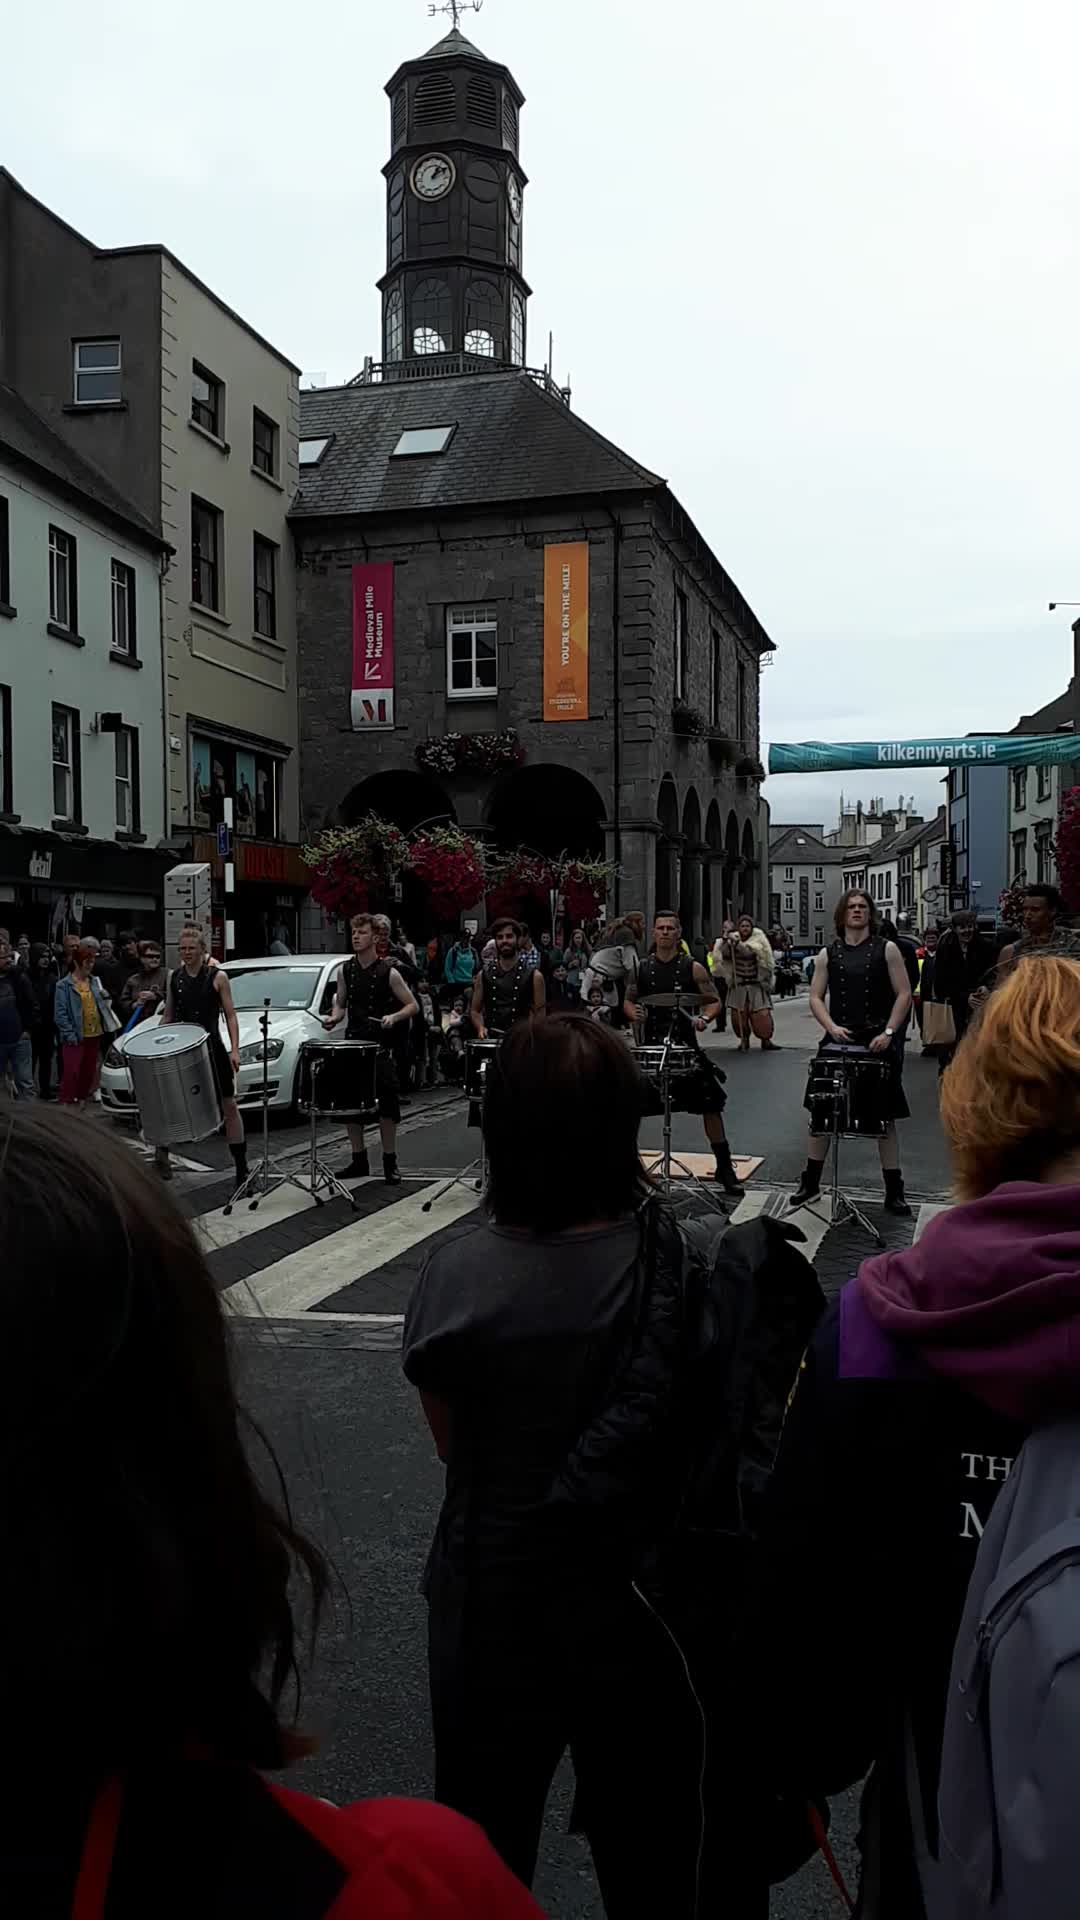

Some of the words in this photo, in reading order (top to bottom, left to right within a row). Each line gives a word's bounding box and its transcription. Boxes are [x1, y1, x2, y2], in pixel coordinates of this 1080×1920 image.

[365, 586, 375, 609] Mile
[561, 592, 570, 611] THE
[561, 613, 570, 629] ON
[365, 610, 375, 659] Medieval
[374, 612, 384, 658] Museum
[561, 629, 570, 667] YOU'RE
[877, 741, 996, 763] kilkennyarts.ie
